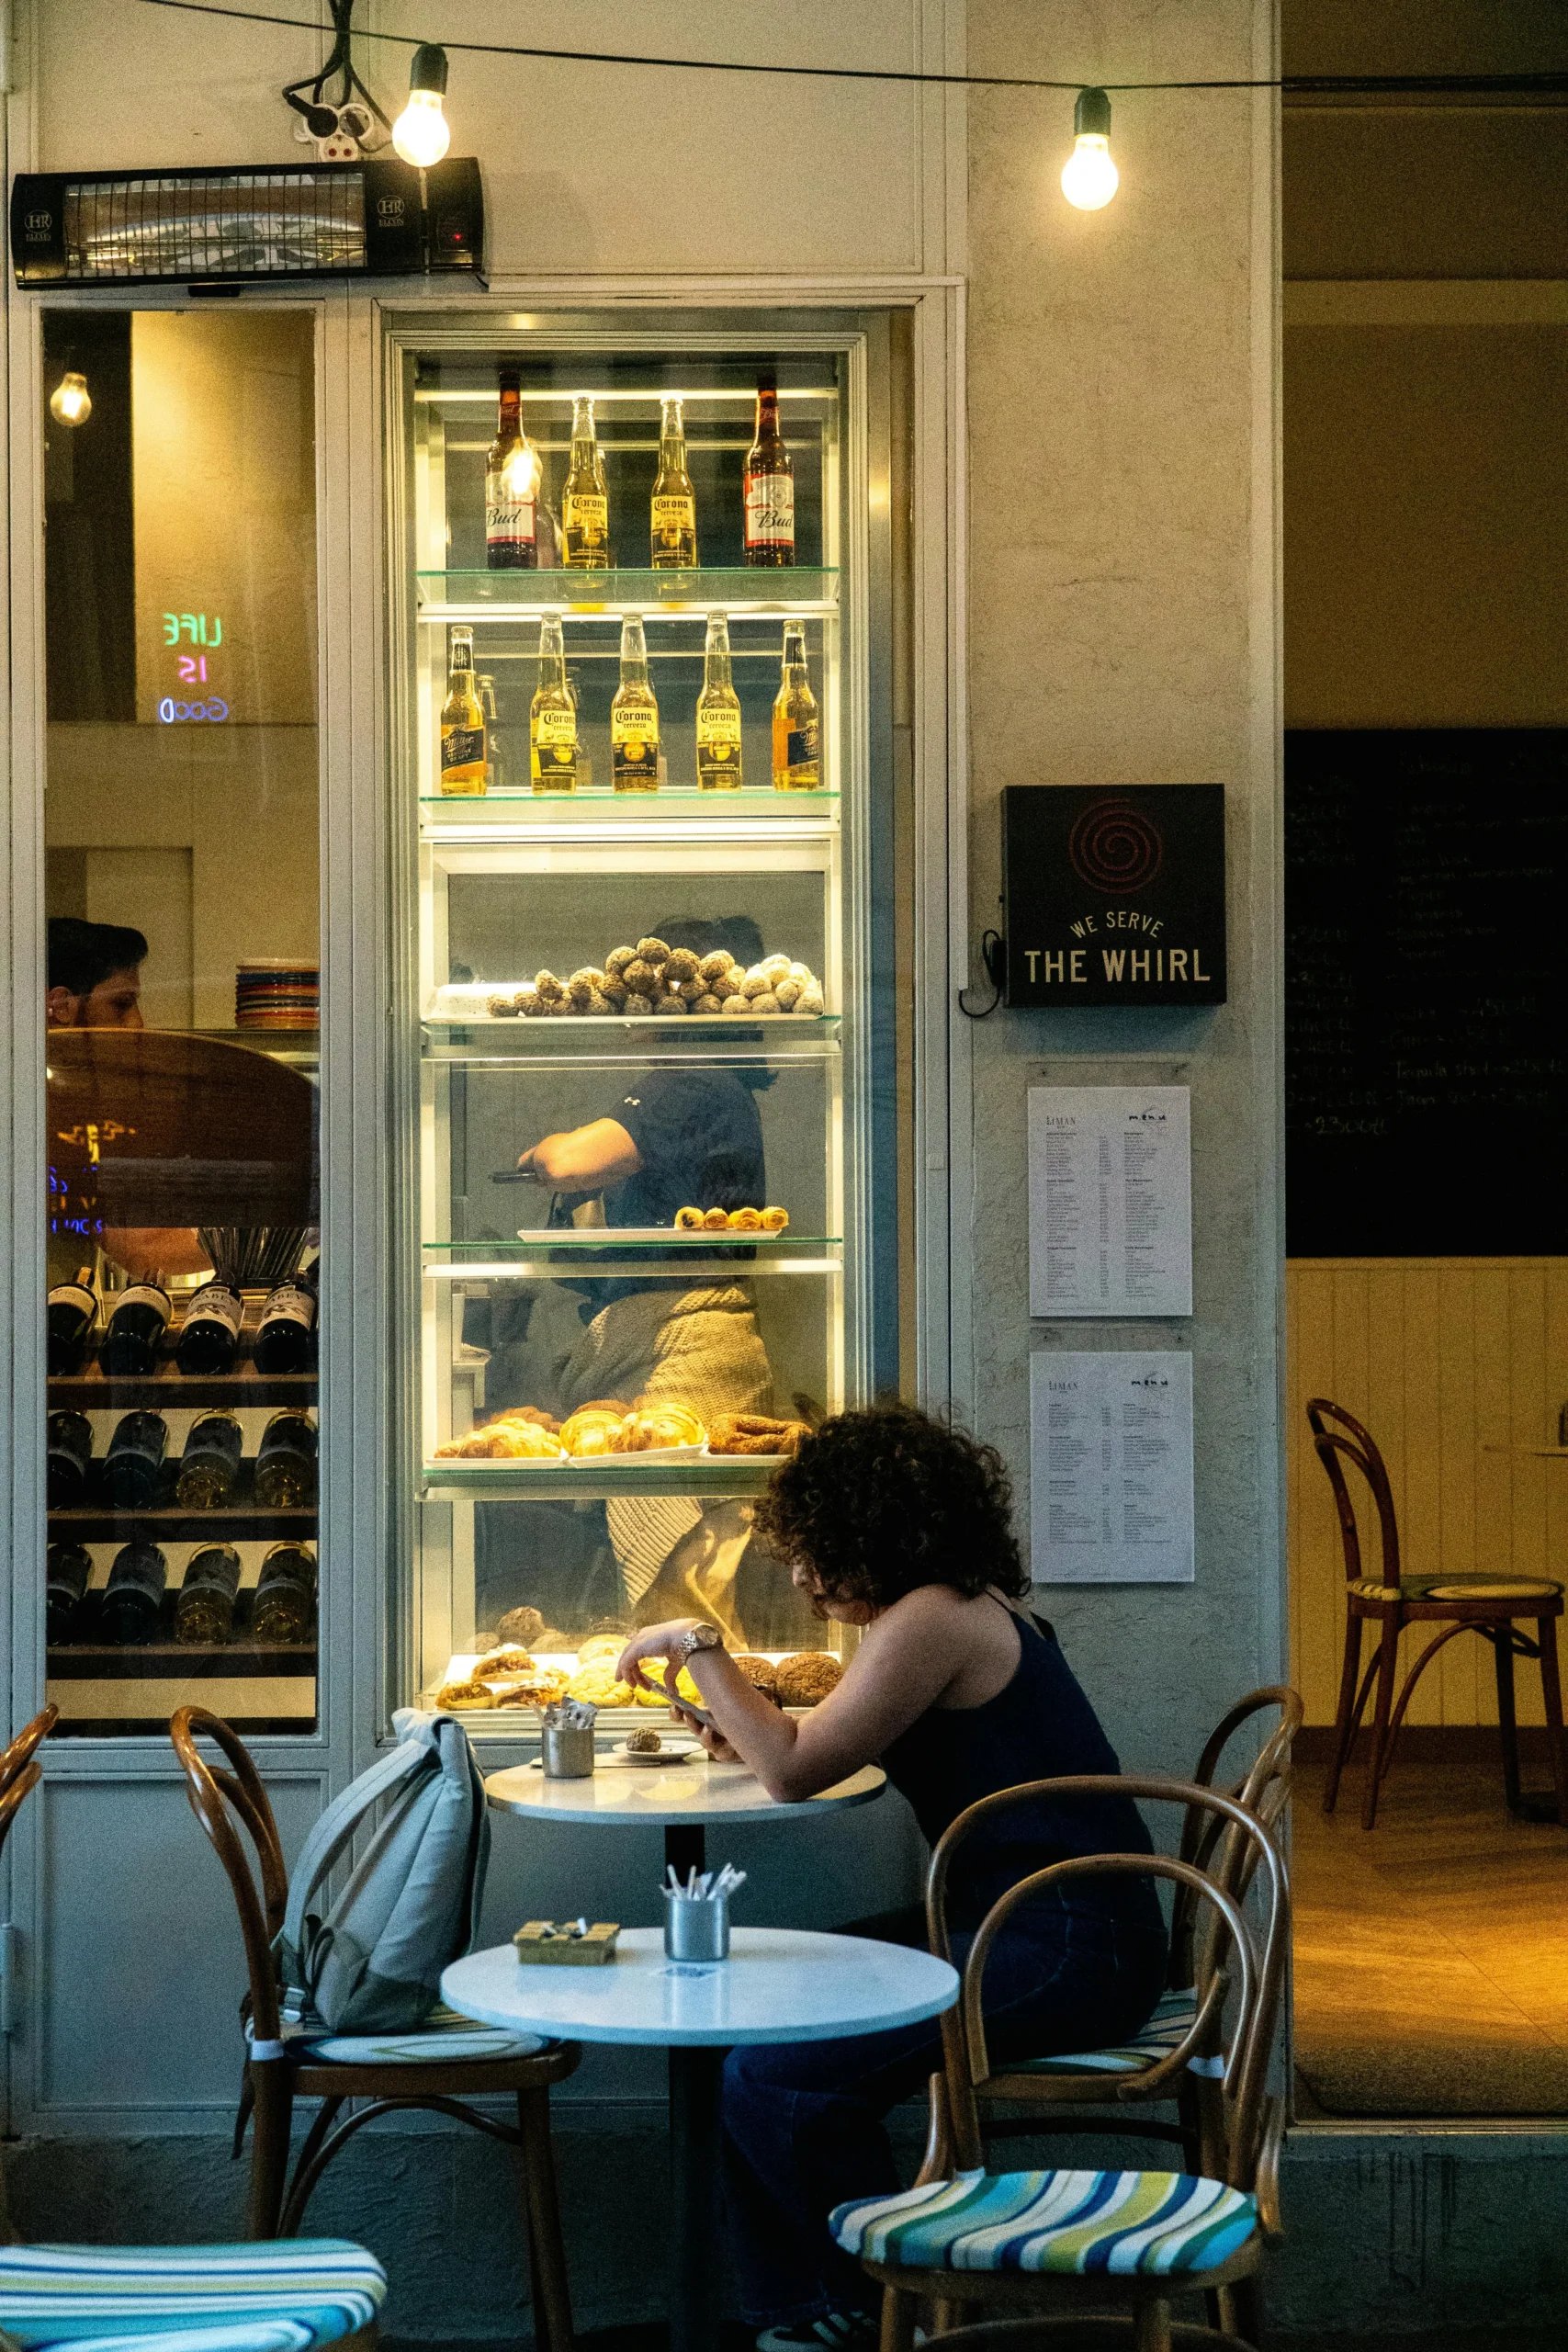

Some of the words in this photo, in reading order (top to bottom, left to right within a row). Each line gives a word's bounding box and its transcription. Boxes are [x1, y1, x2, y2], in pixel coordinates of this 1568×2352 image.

[654, 499, 689, 511] Corona
[486, 508, 522, 527] Bud
[754, 511, 794, 529] Bud
[615, 710, 652, 723] Corona
[701, 711, 736, 723] Corona
[1070, 916, 1099, 938] WE
[1106, 911, 1164, 938] SERVE
[1024, 950, 1088, 983] THE
[1102, 949, 1211, 982] WHIRL
